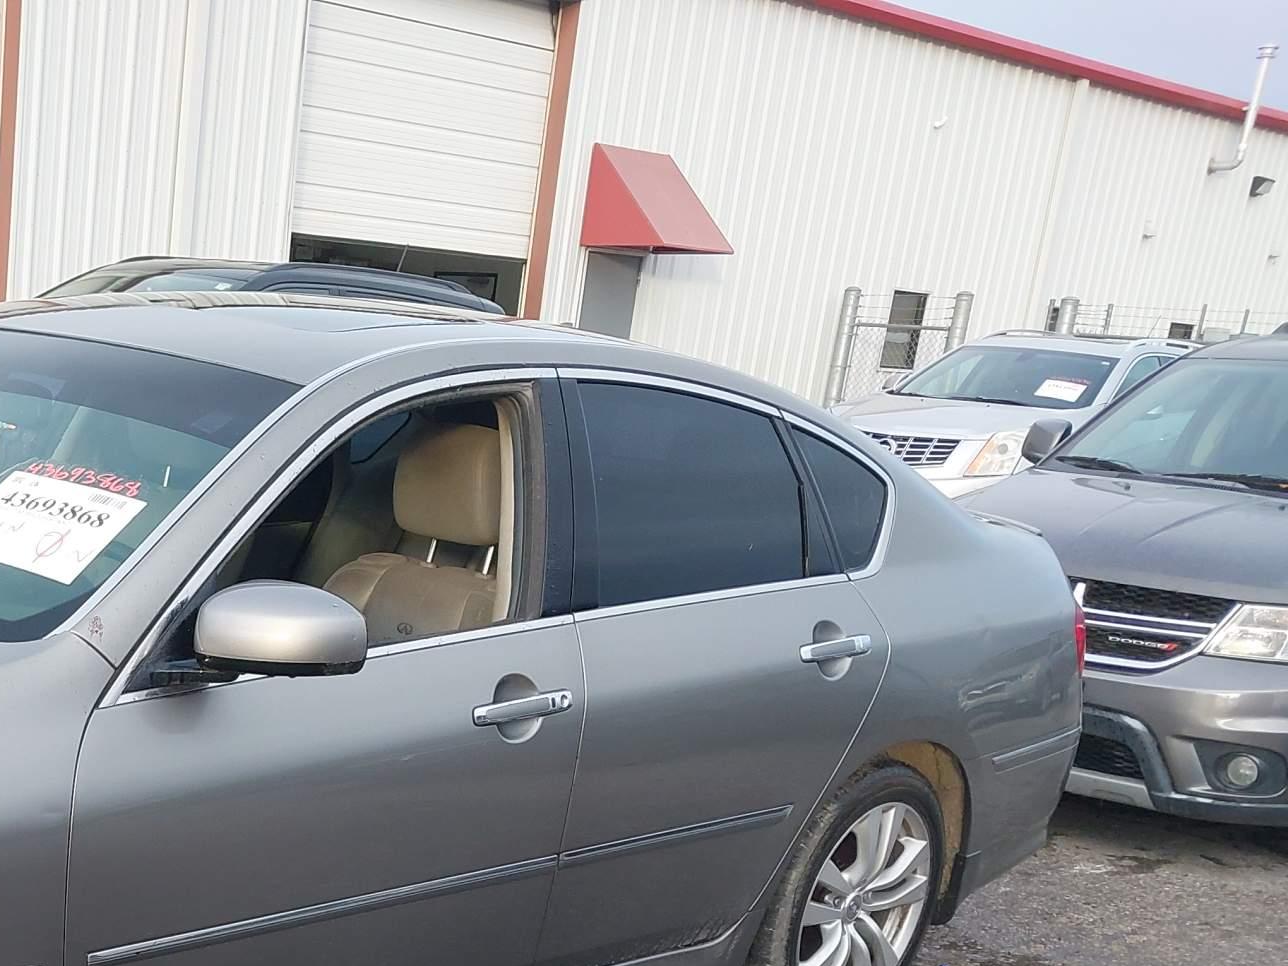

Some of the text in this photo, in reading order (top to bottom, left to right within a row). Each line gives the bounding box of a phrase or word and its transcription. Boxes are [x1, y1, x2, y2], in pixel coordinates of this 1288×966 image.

[25, 463, 141, 497] 43693868
[1, 491, 111, 528] 43693868
[1108, 635, 1169, 649] DODGE
